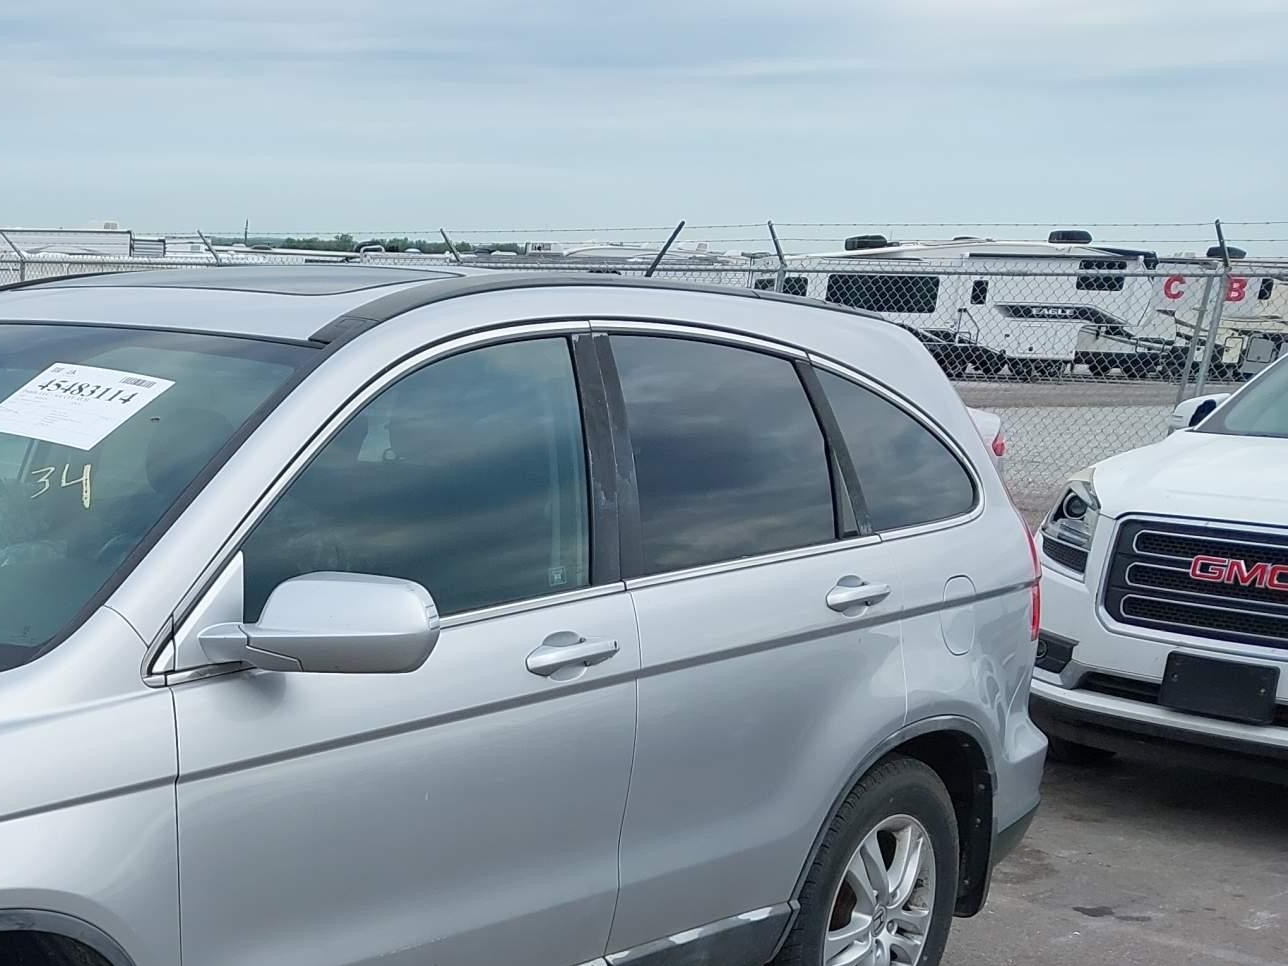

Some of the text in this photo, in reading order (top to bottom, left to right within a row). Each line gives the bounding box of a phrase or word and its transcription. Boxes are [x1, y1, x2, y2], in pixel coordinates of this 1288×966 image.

[1031, 307, 1073, 316] EAGLE
[38, 378, 139, 405] 45483114
[30, 463, 92, 509] 34
[1190, 555, 1288, 591] GMC
